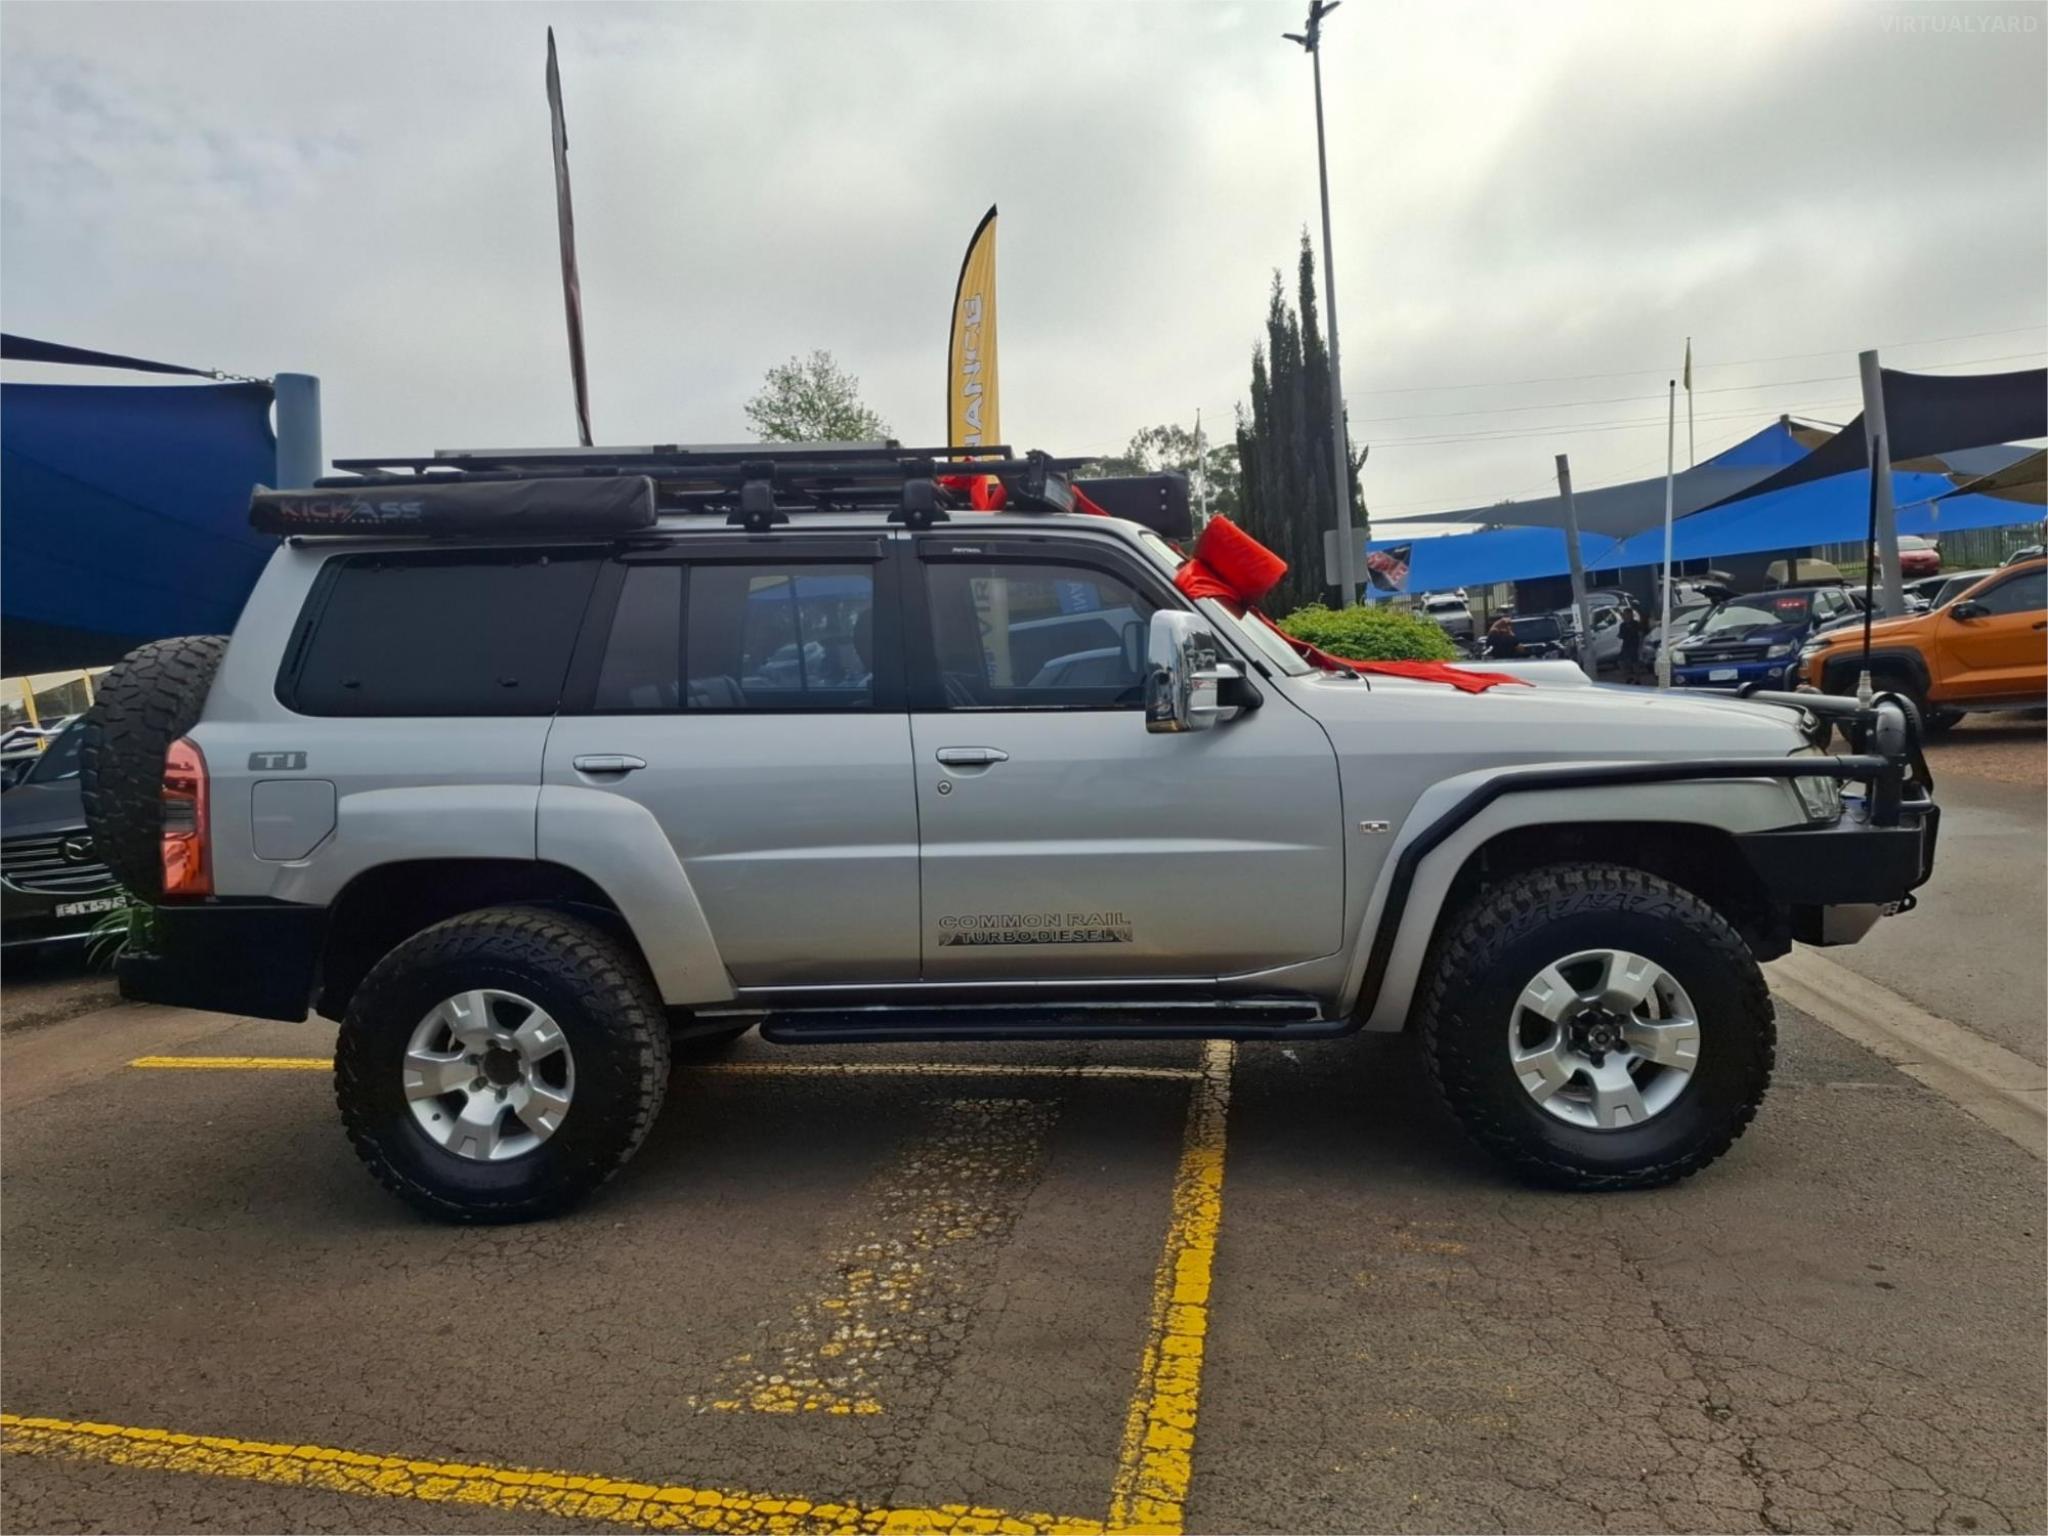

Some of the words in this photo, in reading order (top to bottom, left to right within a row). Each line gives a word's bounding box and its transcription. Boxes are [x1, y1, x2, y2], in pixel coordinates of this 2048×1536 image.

[939, 913, 1062, 929] COMMON
[1067, 912, 1131, 927] RAIL
[959, 930, 1033, 944] TURBO
[1038, 928, 1113, 942] DIESEL
